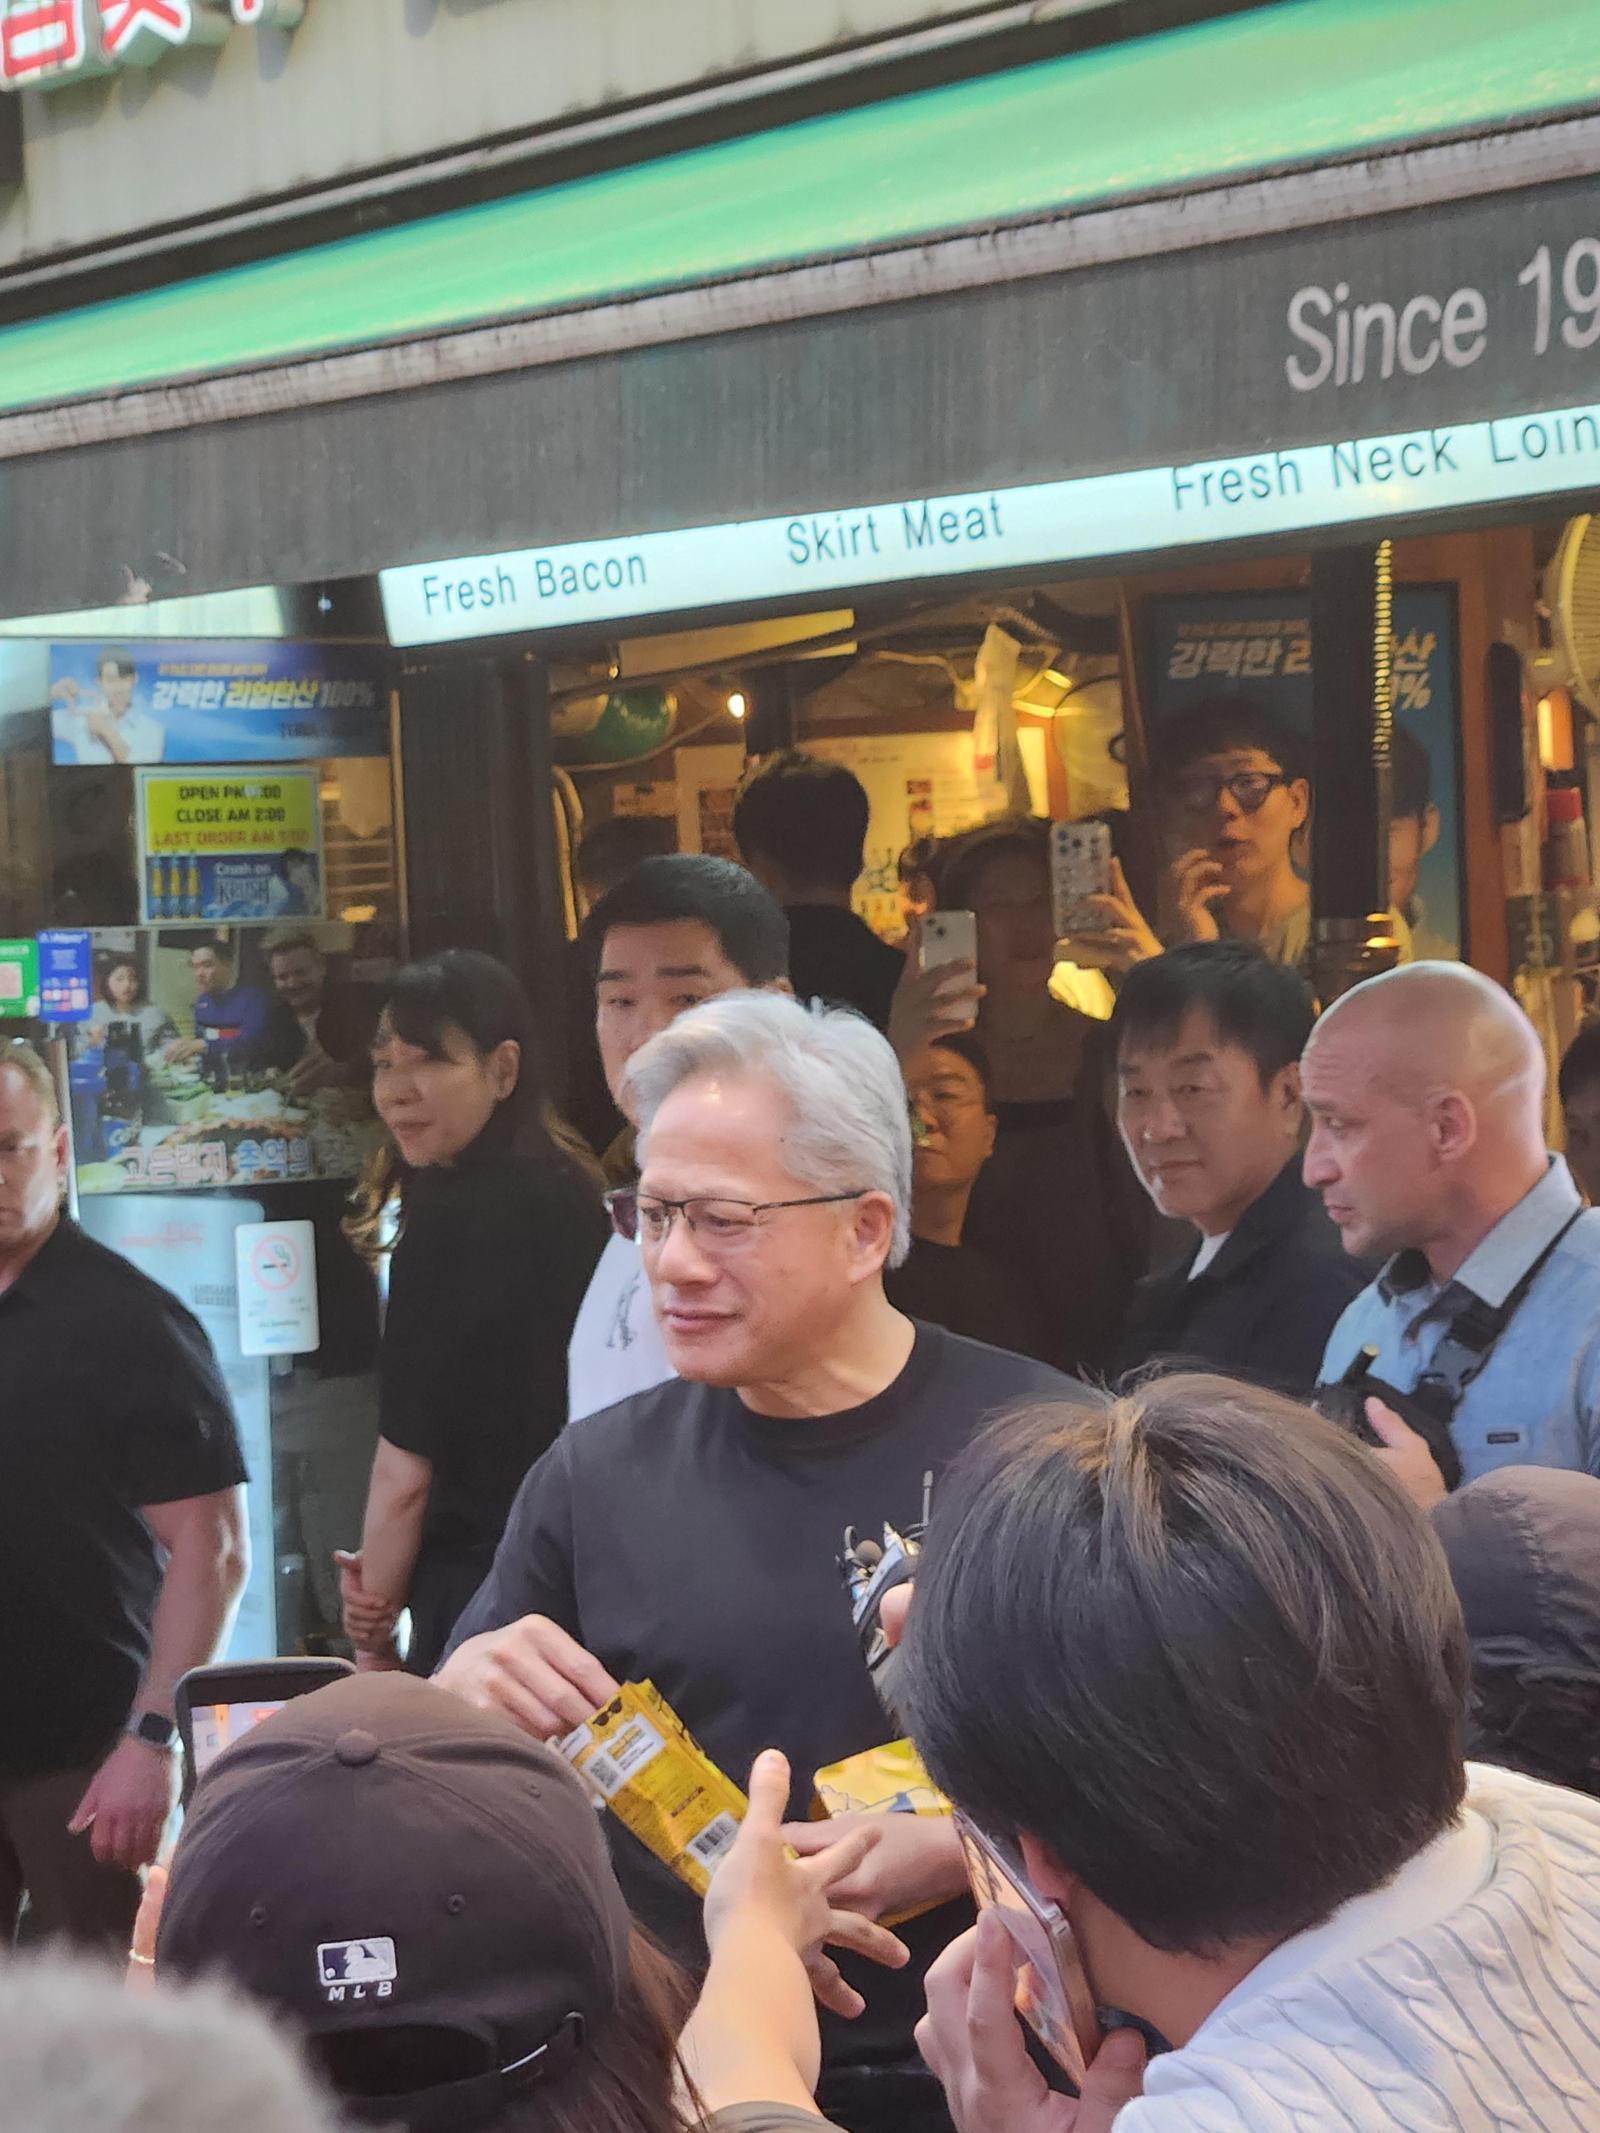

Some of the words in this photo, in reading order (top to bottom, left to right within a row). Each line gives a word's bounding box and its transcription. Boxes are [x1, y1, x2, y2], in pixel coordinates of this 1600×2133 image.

[1285, 281, 1488, 391] Since
[1518, 237, 1600, 356] 19
[1174, 451, 1302, 511] Fresh
[1331, 429, 1459, 489] Neck
[1490, 410, 1600, 463] Loin
[787, 509, 882, 566] Skirt
[903, 495, 1005, 551] Meat
[423, 564, 517, 615] Fresh
[536, 551, 648, 600] Bacon
[179, 785, 220, 801] OPEN
[176, 807, 221, 823] CLOSE
[227, 806, 252, 821] AM
[153, 832, 191, 848] LAST
[328, 1981, 393, 2001] MLB
